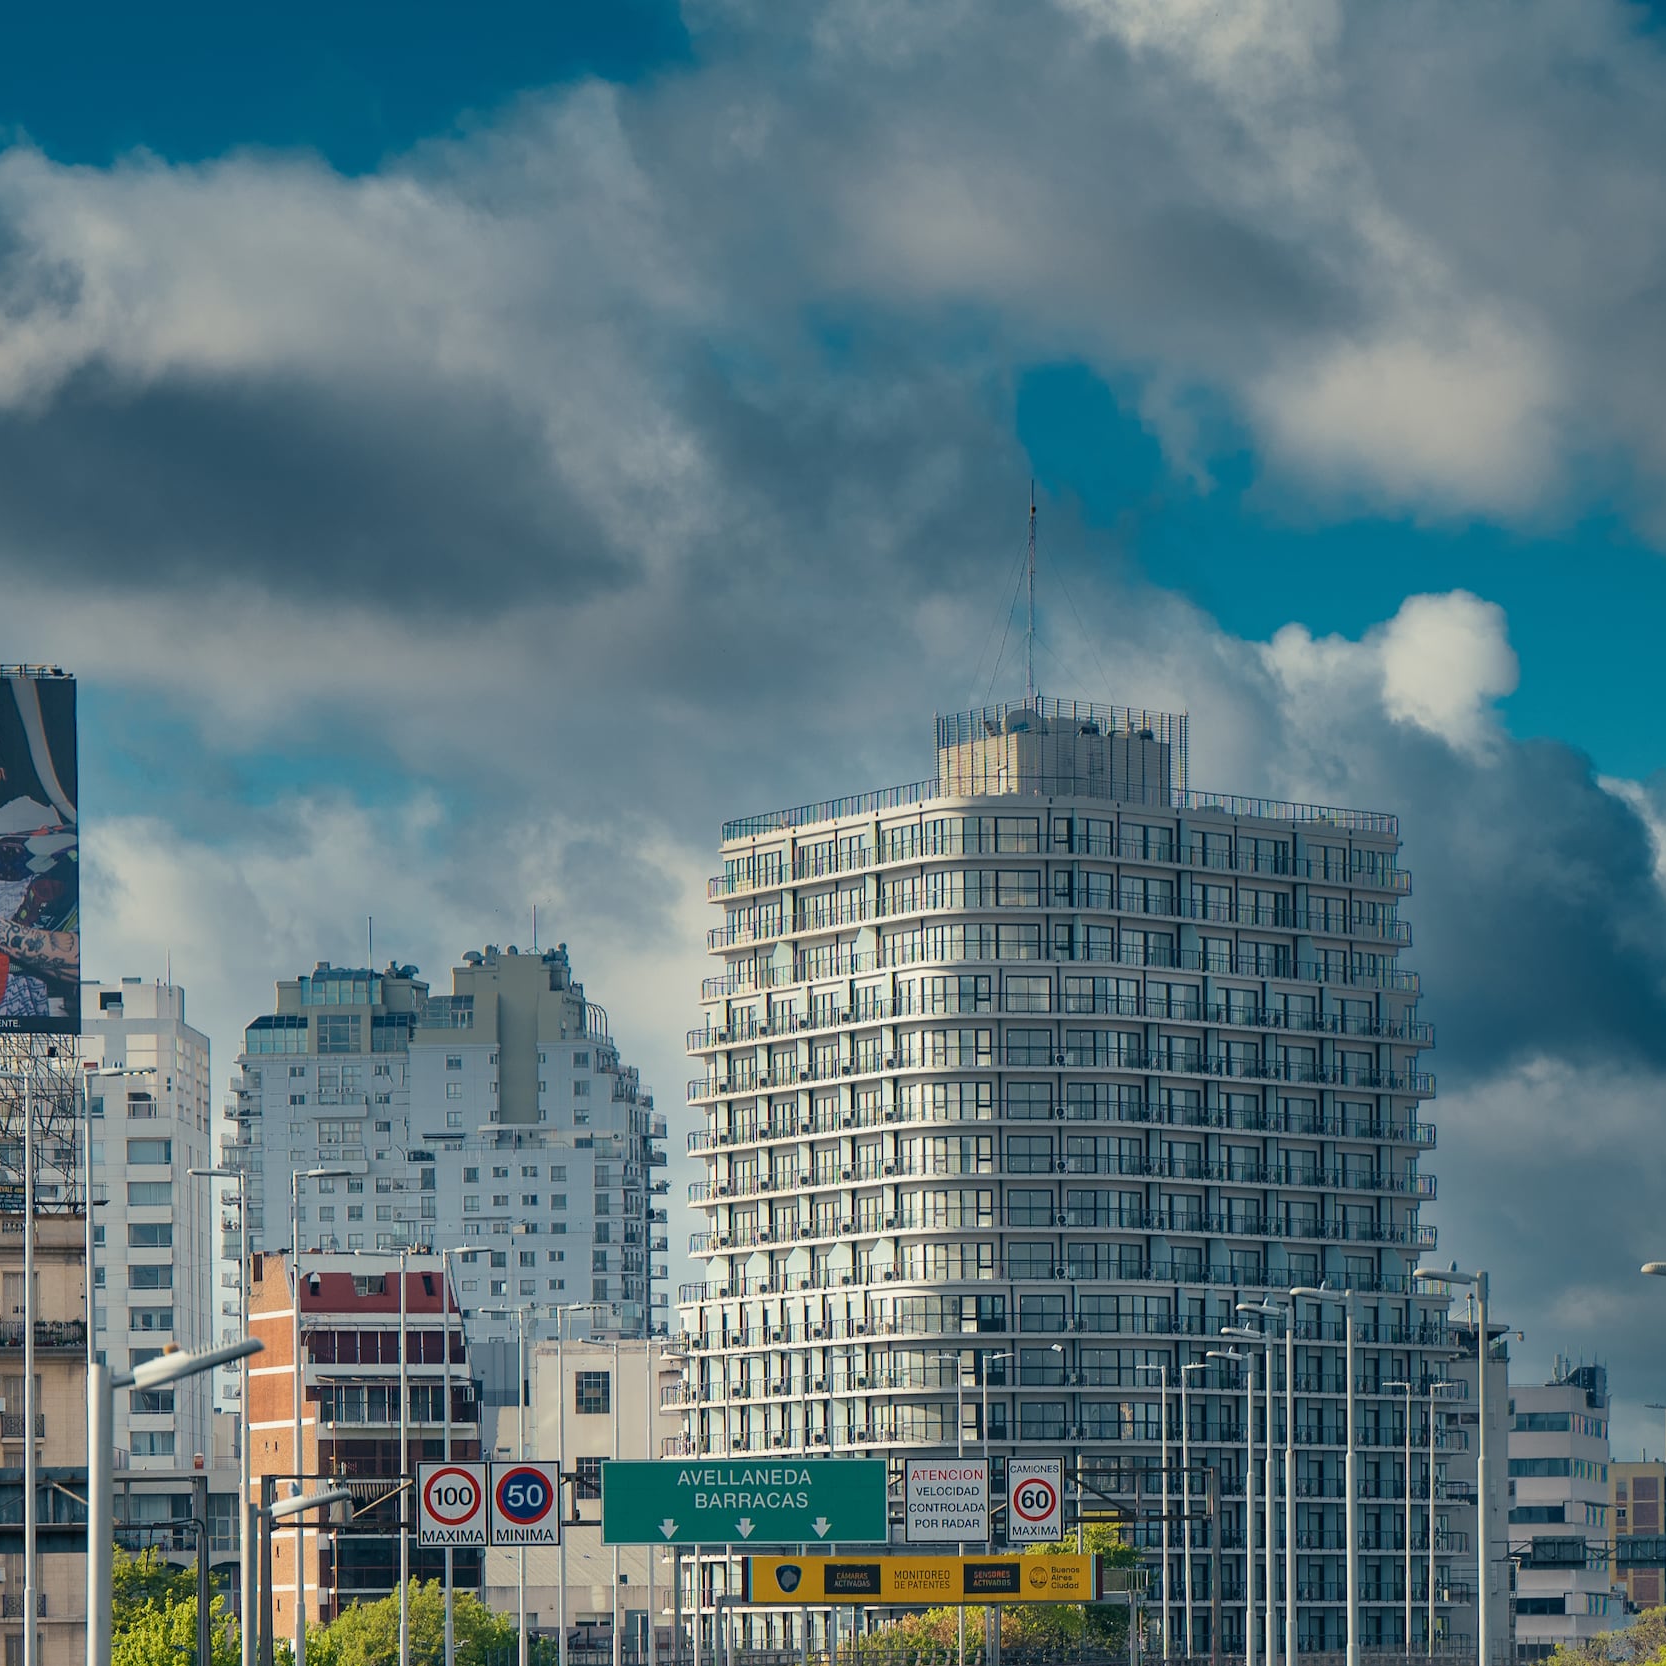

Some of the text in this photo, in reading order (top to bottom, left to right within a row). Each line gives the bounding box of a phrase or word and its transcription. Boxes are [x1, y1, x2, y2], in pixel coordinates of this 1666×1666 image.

[1010, 1464, 1059, 1474] CAMIONES
[677, 1469, 812, 1486] AVELLANEDA
[911, 1469, 983, 1481] ATENCION
[433, 1486, 473, 1506] 100
[507, 1484, 544, 1507] 50
[916, 1486, 980, 1496] VELOCIDAD
[695, 1492, 809, 1509] BARRACAS
[1021, 1489, 1049, 1509] 60
[909, 1503, 986, 1513] CONTROLADA
[915, 1519, 980, 1529] POR RADAR
[496, 1529, 554, 1541] MINIMA
[1012, 1526, 1058, 1536] MAXIMA
[422, 1530, 484, 1543] MAXIMA
[894, 1569, 950, 1580] MONITOREO
[973, 1570, 1011, 1579] SENSORES
[1051, 1566, 1080, 1574] Buenos
[834, 1580, 871, 1588] ACTIVADAS
[894, 1580, 950, 1589] DE PATENTES
[973, 1579, 1012, 1587] ACTIVADOS
